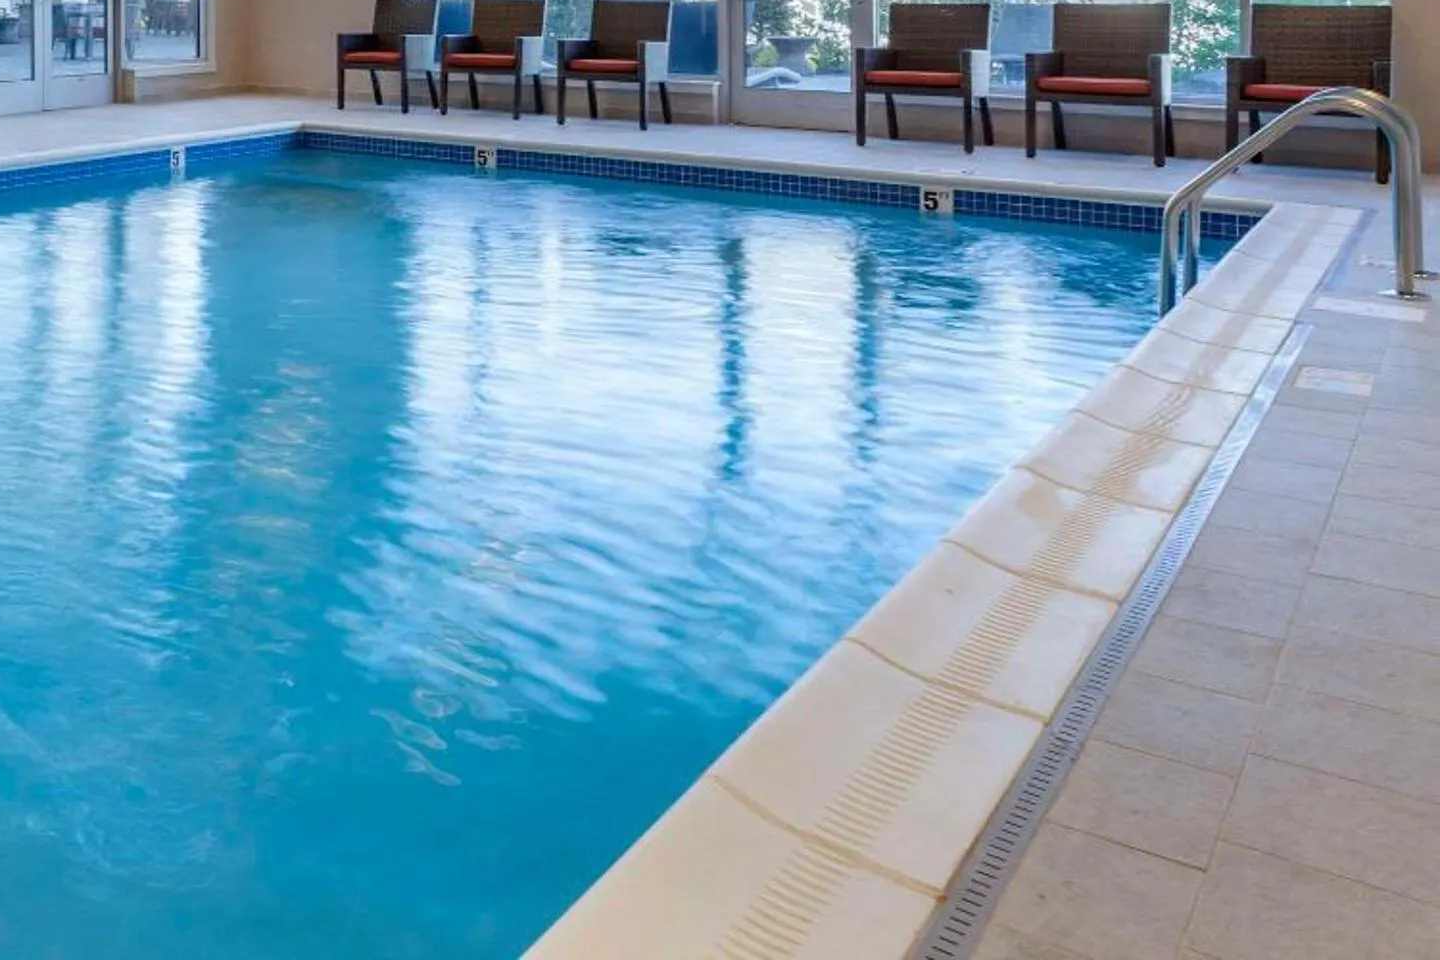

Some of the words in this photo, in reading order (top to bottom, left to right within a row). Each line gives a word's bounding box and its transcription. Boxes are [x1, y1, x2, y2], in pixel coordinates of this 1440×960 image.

[172, 151, 180, 166] 5
[478, 150, 488, 166] 5
[924, 191, 938, 210] 5
